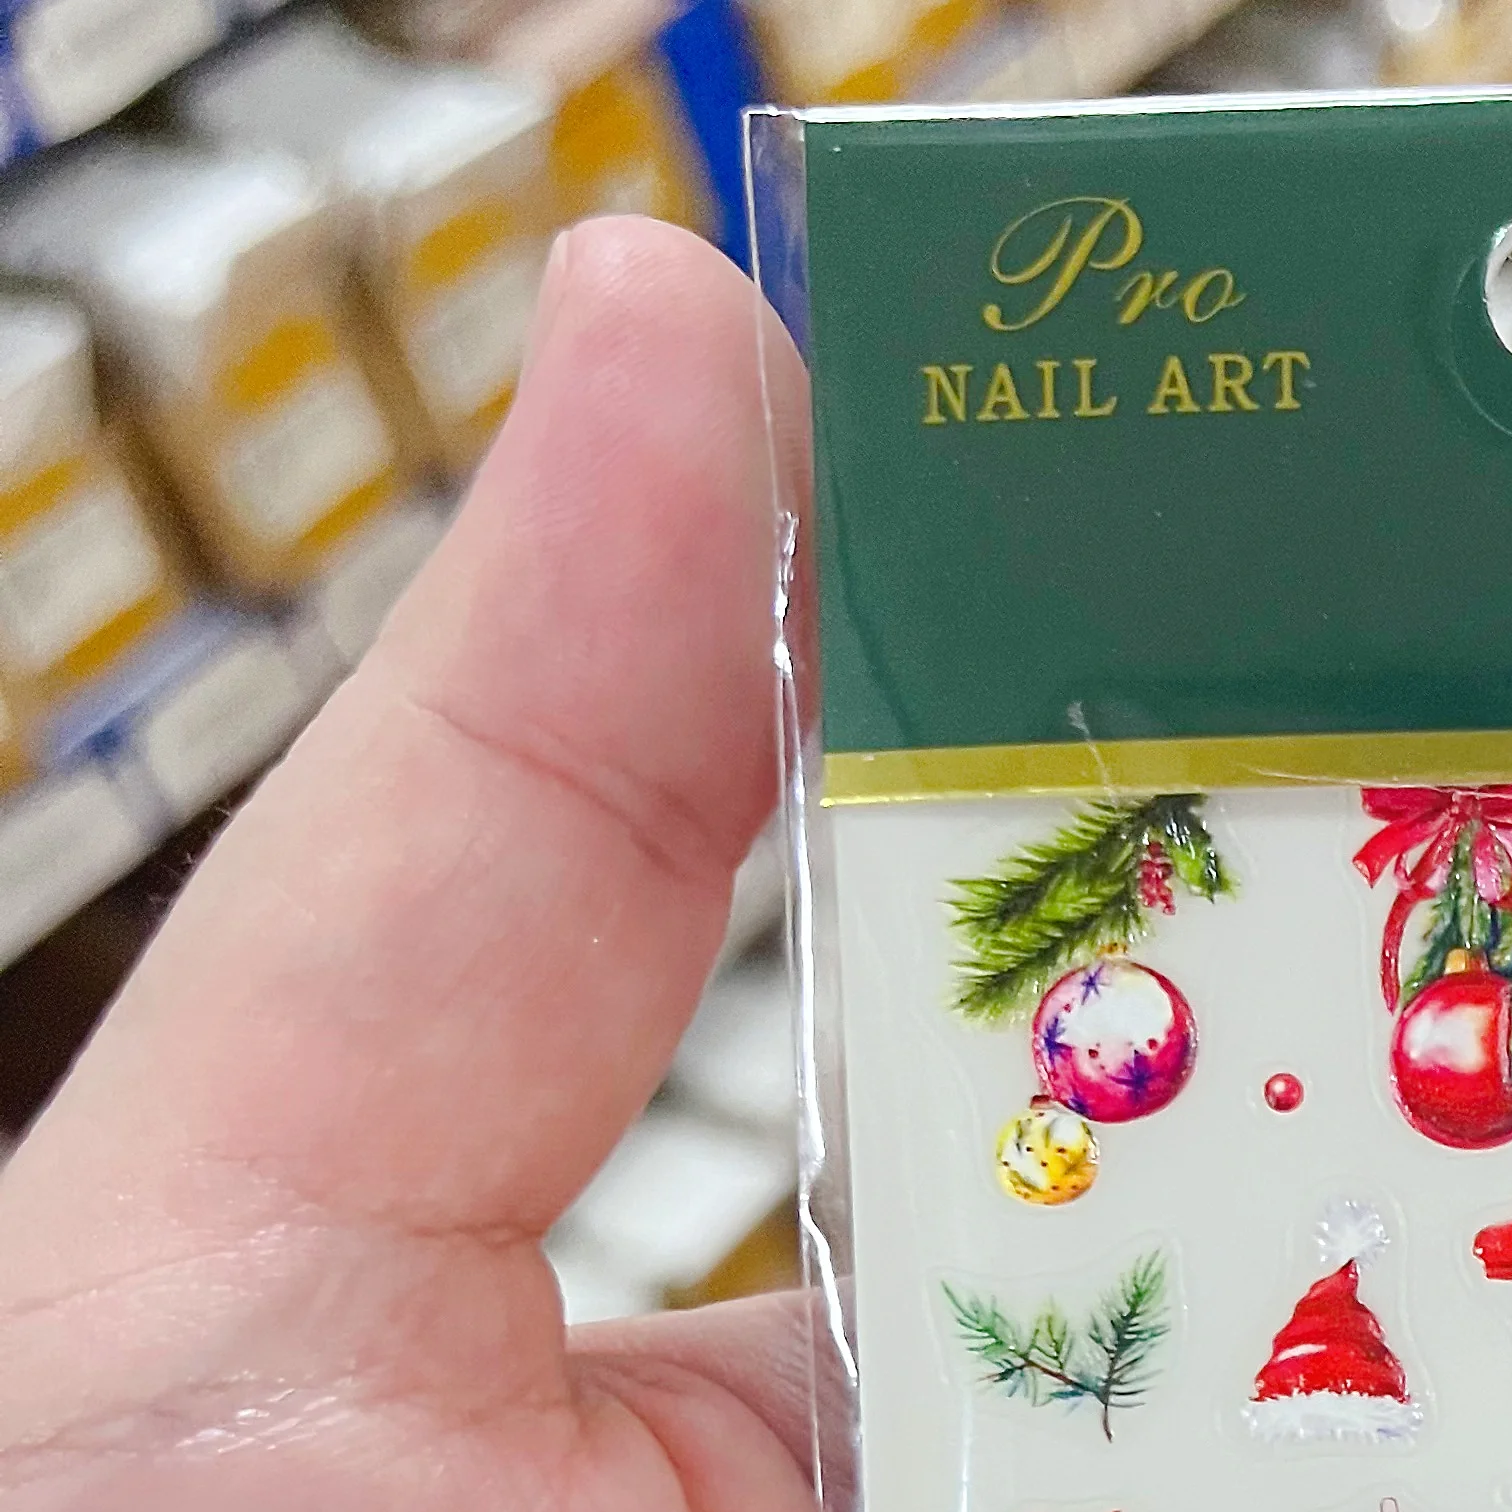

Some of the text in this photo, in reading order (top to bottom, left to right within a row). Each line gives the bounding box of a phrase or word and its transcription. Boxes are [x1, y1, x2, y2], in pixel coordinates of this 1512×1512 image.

[982, 196, 1247, 331] Pro
[921, 351, 1312, 425] NAIL ART
